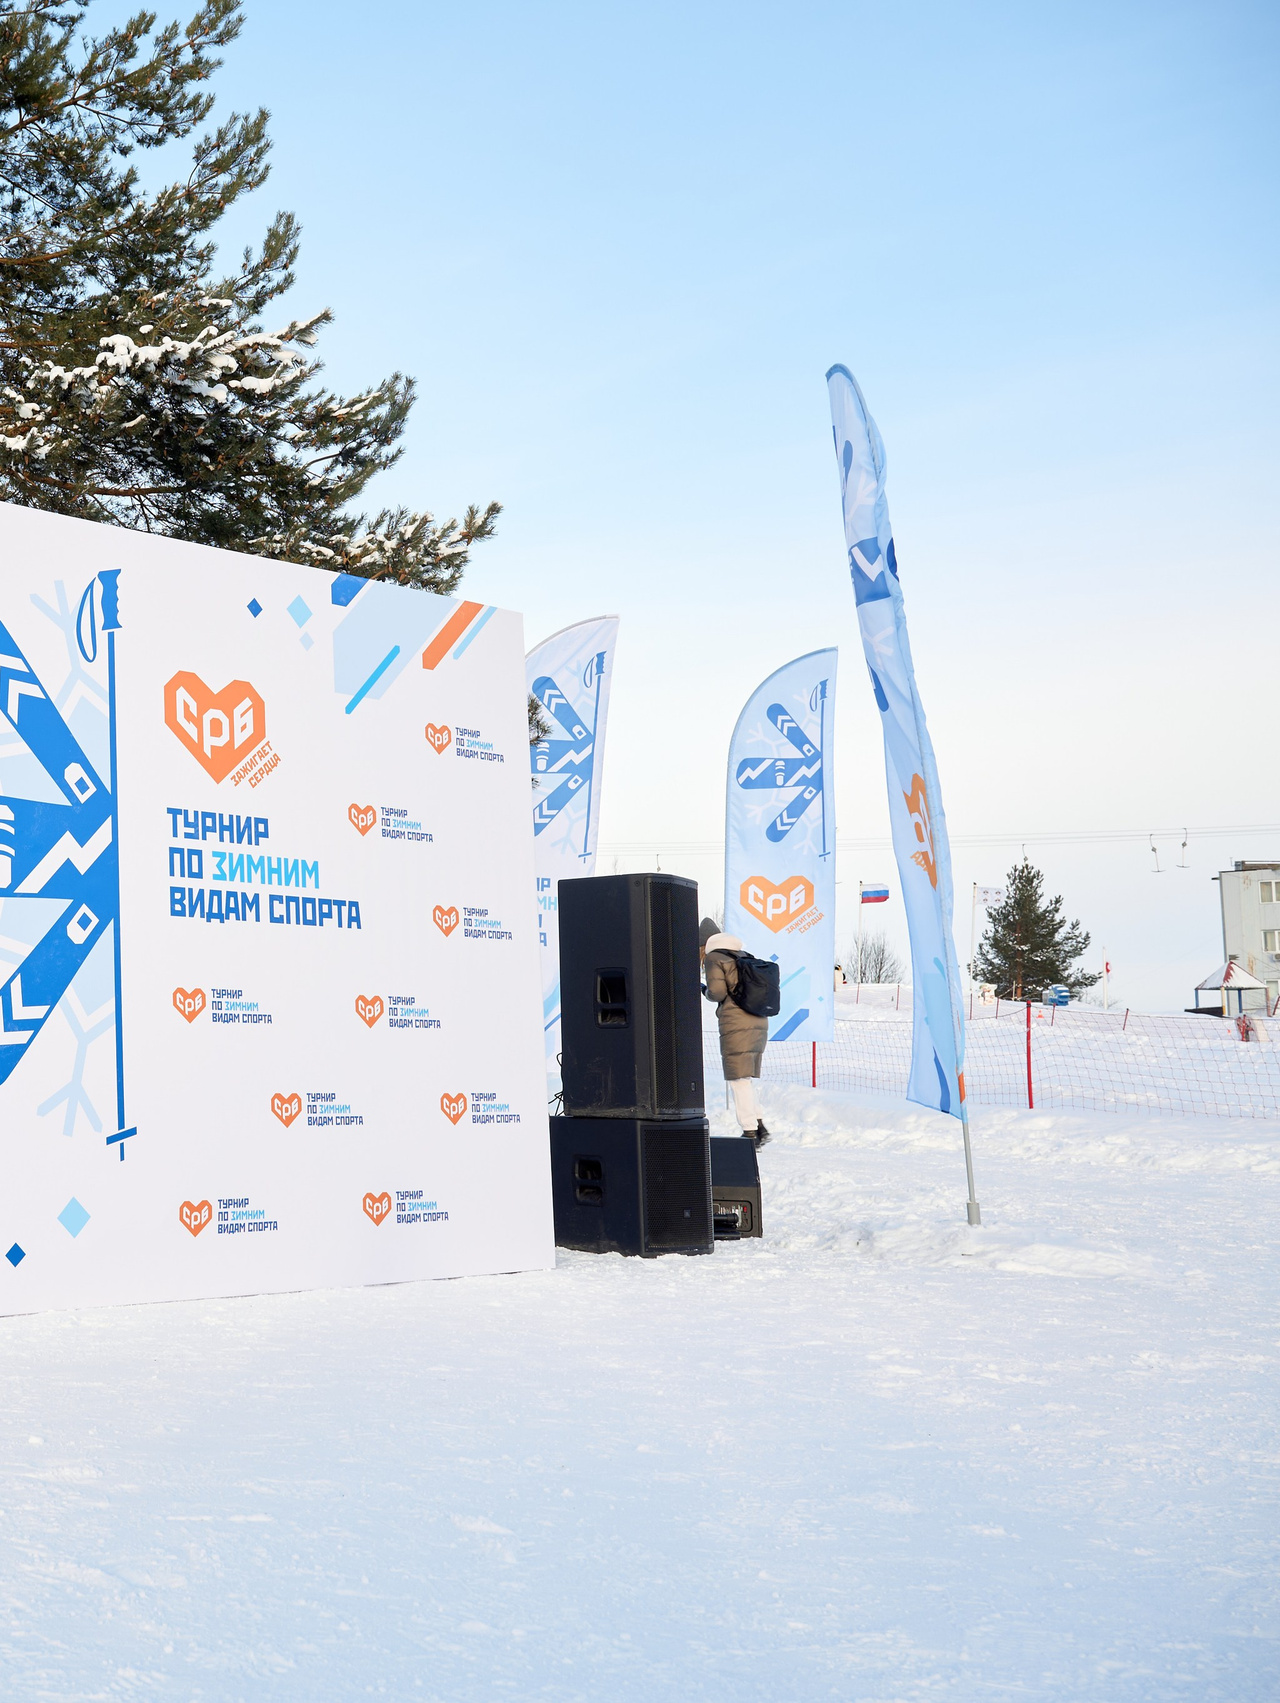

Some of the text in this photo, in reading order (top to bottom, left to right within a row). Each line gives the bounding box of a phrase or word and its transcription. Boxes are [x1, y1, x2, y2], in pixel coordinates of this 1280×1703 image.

[455, 727, 480, 738] ТУРНИР
[456, 738, 493, 751] ПО ЗИМНИМ
[457, 748, 504, 763] ВИДАМ СПОРТА
[230, 740, 273, 787] ЗАЖИГАЕТ
[247, 752, 281, 789] СЕРДЦА
[381, 807, 407, 818] ТУРНИР
[167, 807, 269, 846] ТУРНИР
[381, 818, 421, 831] ПО ЗИМНИМ
[382, 829, 433, 842] ВИДАМ СПОРТА
[169, 847, 319, 889] ПО ЗИМНИМ
[170, 886, 361, 929] ВИДАМ СПОРТА
[463, 907, 488, 917] ТУРНИР
[464, 918, 501, 928] ПО ЗИМНИМ
[785, 906, 819, 934] ЗАЖИГАЕТ
[798, 912, 825, 934] СЕРДЦА
[464, 929, 512, 940] ВИДАМ СПОРТА
[211, 989, 242, 999] ТУРНИР
[212, 1001, 258, 1011] ПО ЗИМНИМ
[388, 996, 415, 1005] ТУРНИР
[389, 1007, 429, 1017] ПО ЗИМНИМ
[212, 1013, 272, 1024] ВИДАМ СПОРТА
[389, 1018, 441, 1028] ВИДАМ СПОРТА
[307, 1093, 335, 1102] ТУРНИР
[471, 1093, 496, 1101] ТУРНИР
[307, 1105, 350, 1114] ПО ЗИМНИМ
[472, 1104, 509, 1112] ПО ЗИМНИМ
[308, 1116, 363, 1127] ВИДАМ СПОРТА
[472, 1114, 520, 1124] ВИДАМ СПОРТА
[396, 1190, 423, 1200] ТУРНИР
[218, 1198, 249, 1209] ТУРНИР
[397, 1201, 437, 1212] ПО ЗИМНИМ
[218, 1210, 265, 1221] ПО ЗИМНИМ
[397, 1212, 449, 1224] ВИДАМ СПОРТА
[218, 1222, 278, 1234] ВИДАМ СПОРТА
